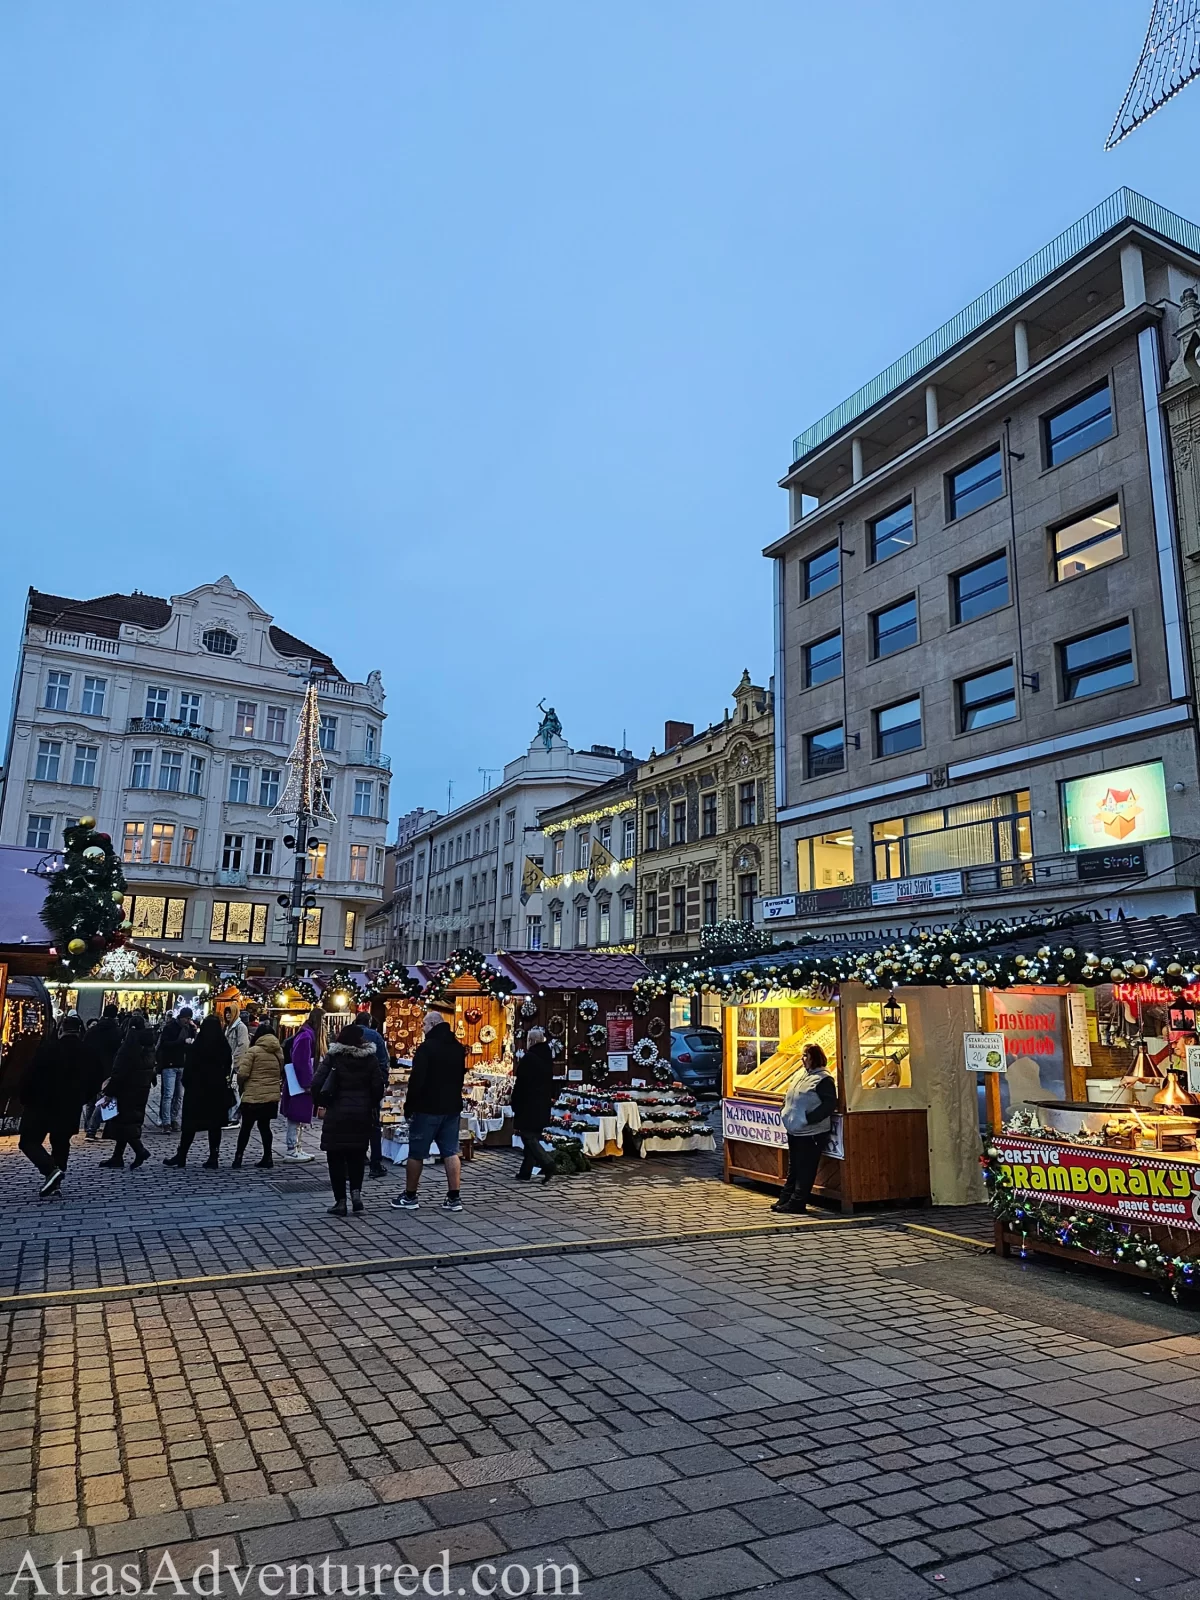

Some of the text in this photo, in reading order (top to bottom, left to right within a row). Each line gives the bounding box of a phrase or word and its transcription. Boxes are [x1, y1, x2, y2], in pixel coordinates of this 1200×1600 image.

[1103, 854, 1141, 869] Strejc
[769, 907, 782, 917] 97
[726, 1106, 781, 1127] MARCIPÁNO
[727, 1123, 772, 1143] OVOCNÉ
[1001, 1161, 1192, 1198] BRAMBORÁKY
